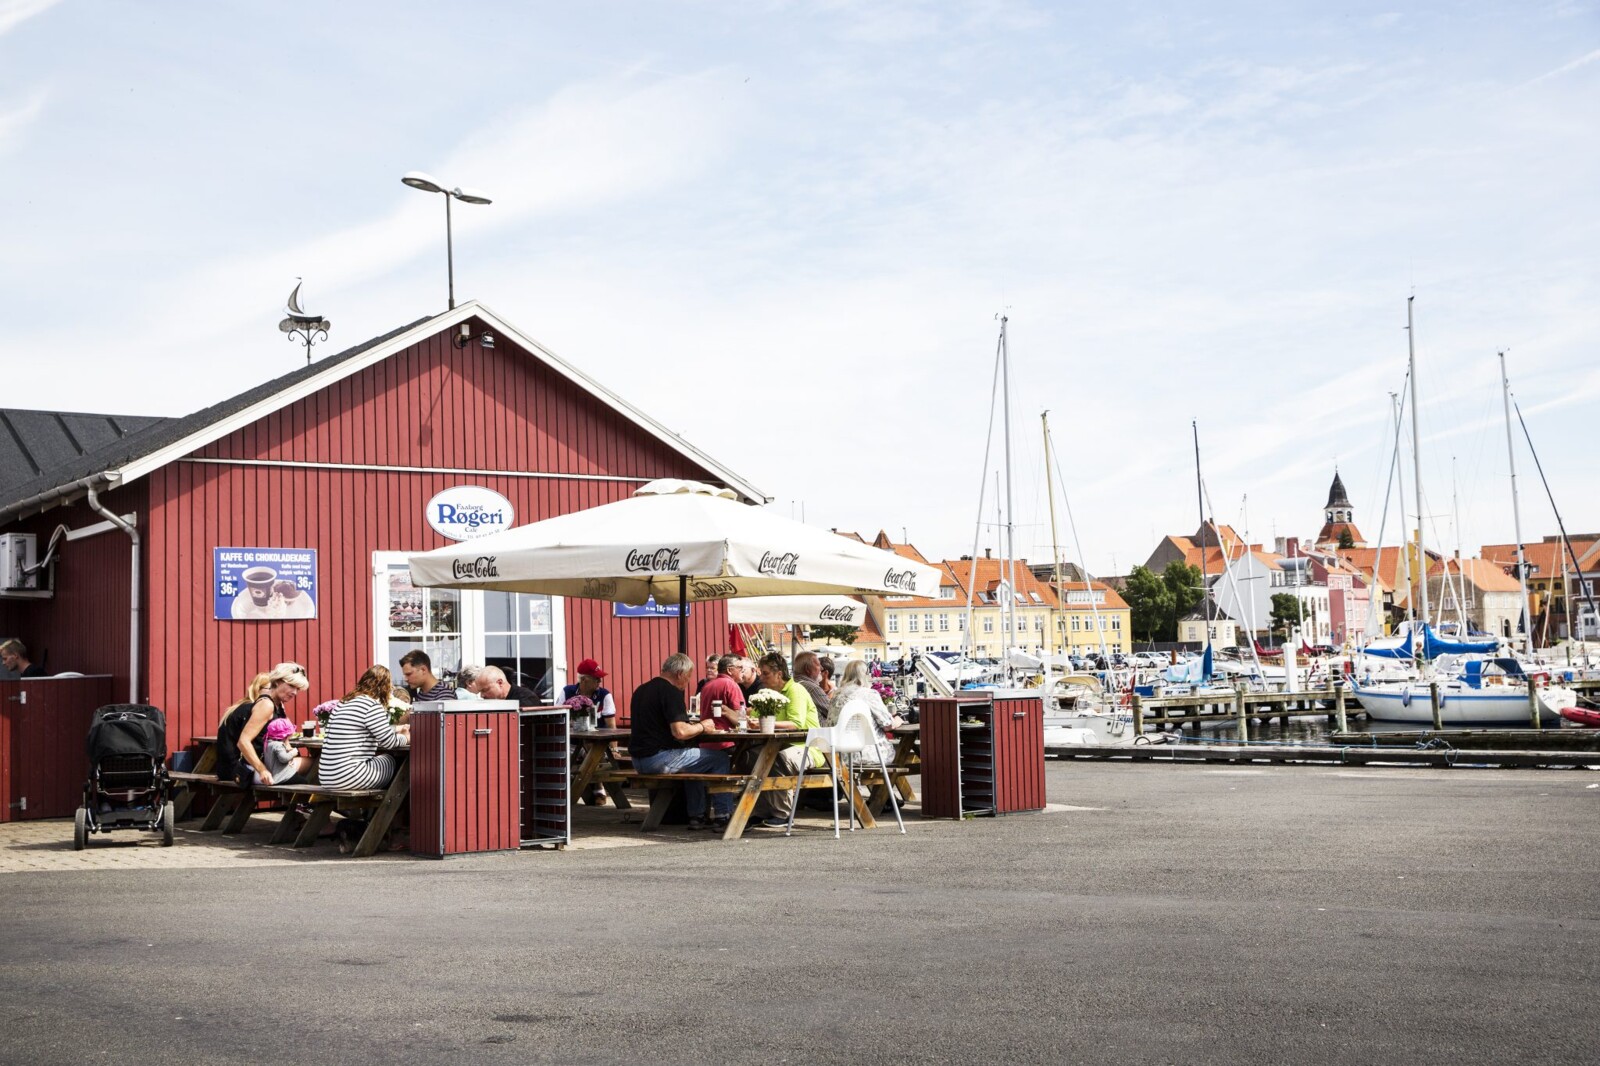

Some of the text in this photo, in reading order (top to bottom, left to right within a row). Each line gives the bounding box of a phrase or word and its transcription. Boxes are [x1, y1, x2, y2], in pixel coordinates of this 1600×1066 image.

[437, 504, 503, 528] Røgeri
[456, 503, 484, 511] Faaborg
[220, 552, 311, 563] KAFFE OG CHOKOLADEKAGE
[452, 556, 499, 580] Coca-Cola
[625, 548, 681, 572] Coca-Cola
